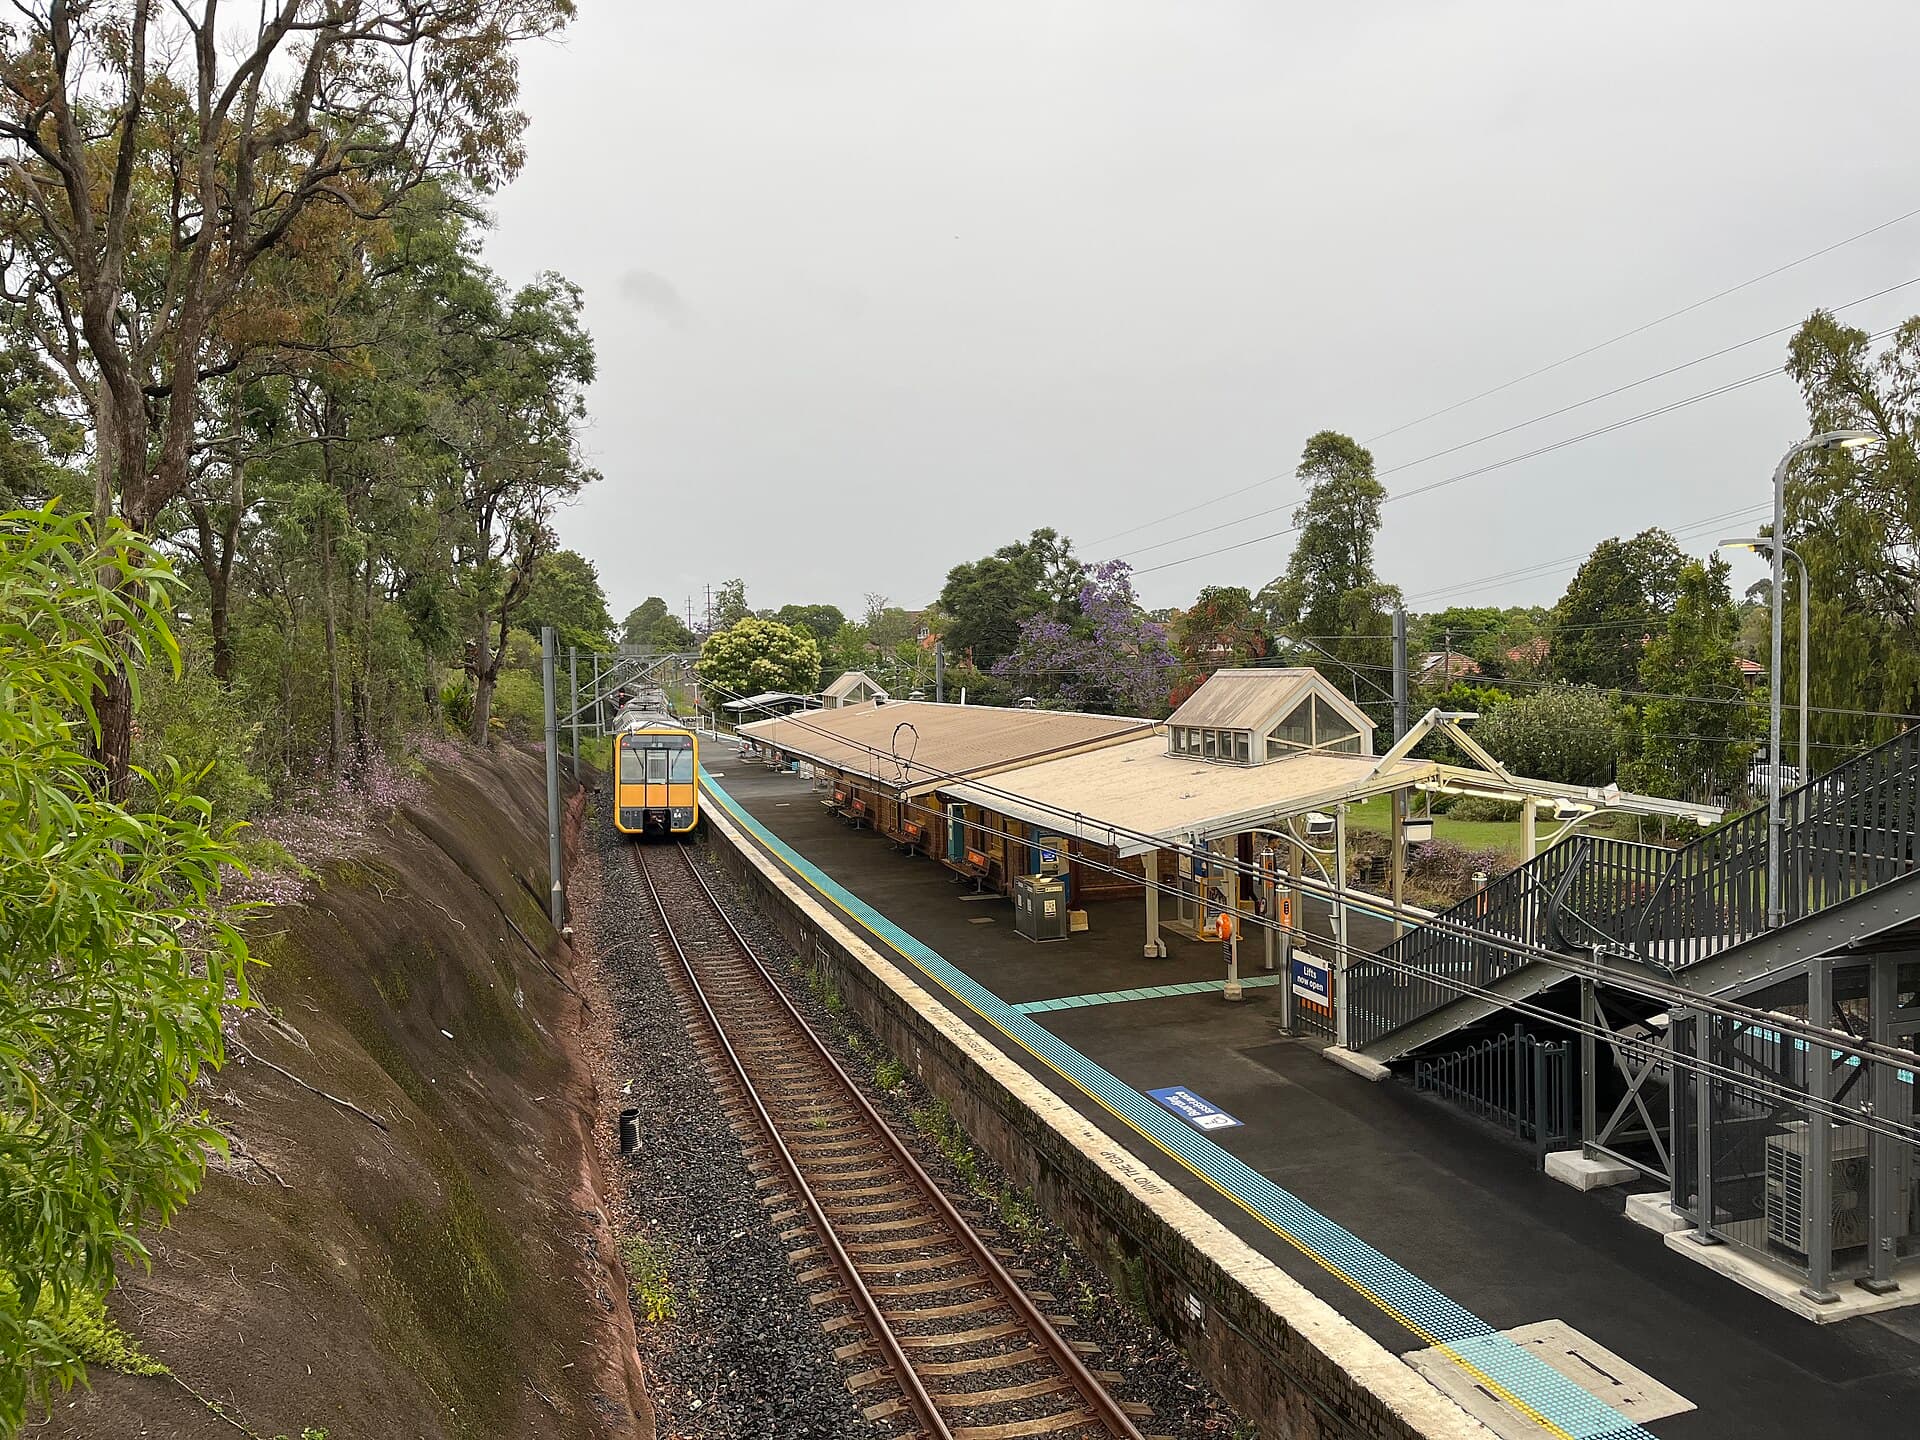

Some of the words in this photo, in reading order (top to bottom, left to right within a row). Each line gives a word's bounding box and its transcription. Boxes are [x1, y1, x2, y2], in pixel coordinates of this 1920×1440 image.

[1303, 966, 1317, 979] Lifts
[1297, 975, 1309, 986] now
[1309, 981, 1324, 992] open
[1100, 1151, 1124, 1164] GAP
[1116, 1164, 1141, 1178] THE
[1133, 1178, 1164, 1195] MIND
